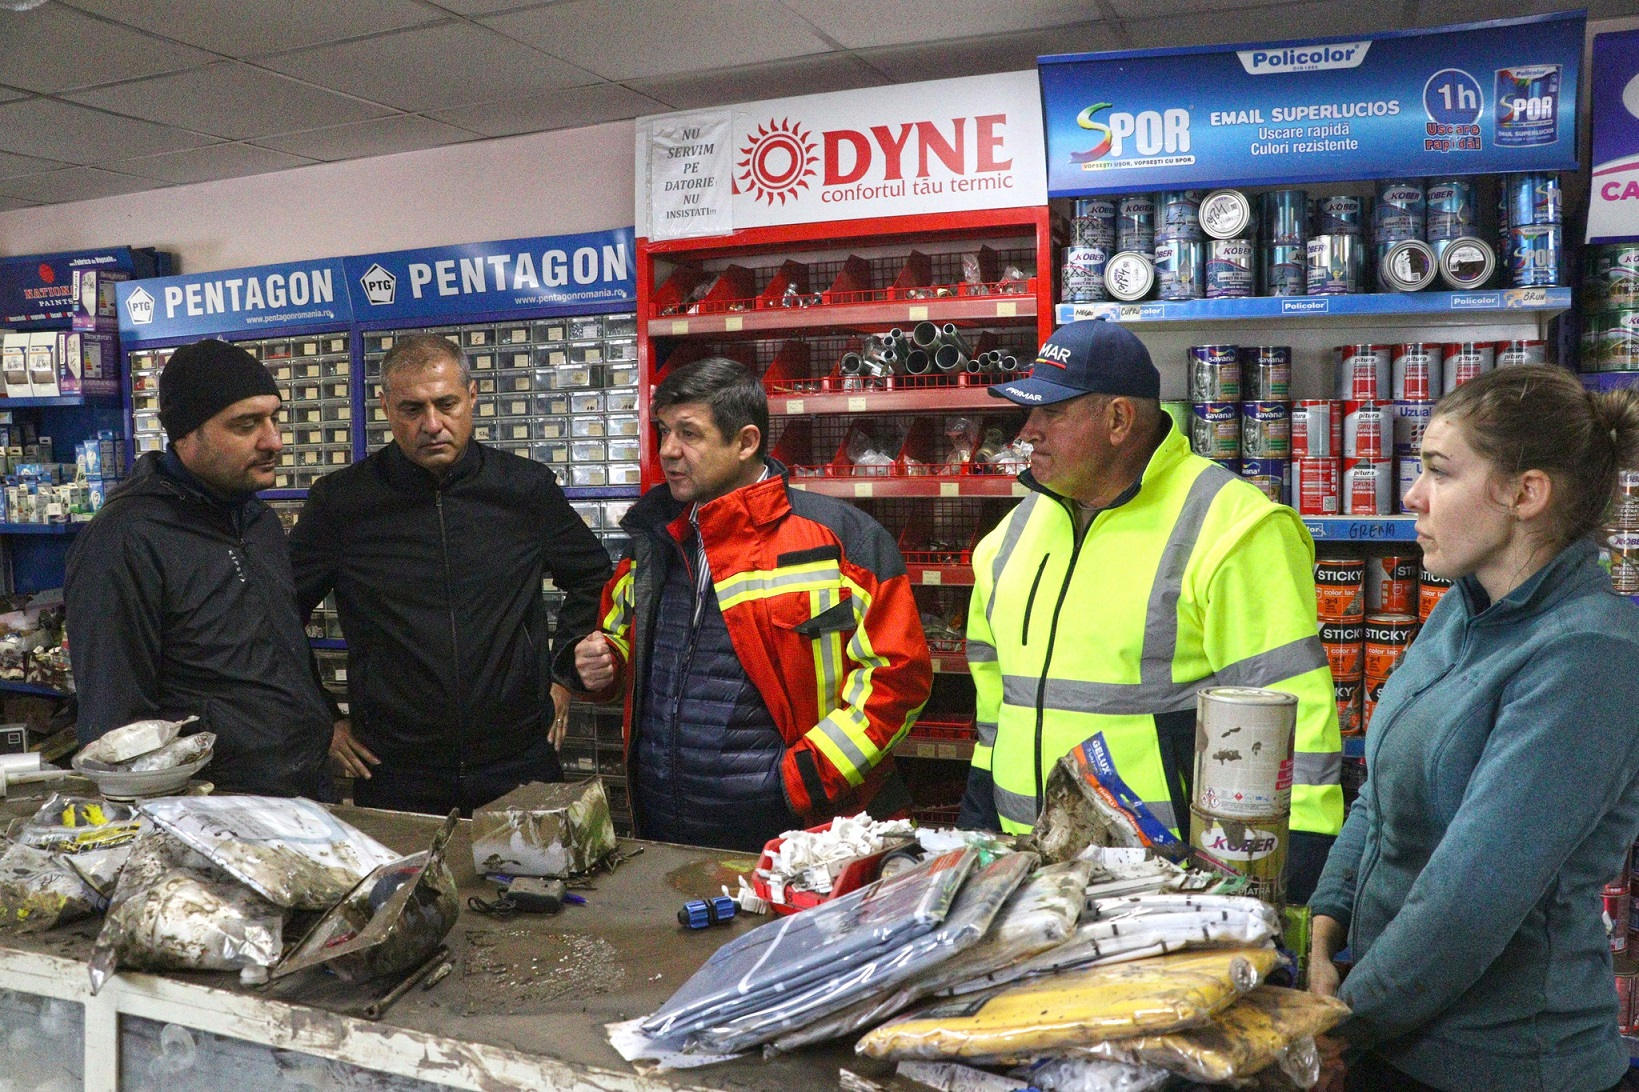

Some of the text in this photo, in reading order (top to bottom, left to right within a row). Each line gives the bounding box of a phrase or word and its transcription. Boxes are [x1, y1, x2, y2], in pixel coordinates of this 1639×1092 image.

[1253, 47, 1355, 68] Policolor
[1210, 100, 1400, 126] EMAIL SUPERLUCIOS
[1499, 93, 1553, 124] SPOR
[681, 128, 700, 141] NU
[1070, 102, 1191, 164] SPOR
[1259, 122, 1350, 140] Uscare rapidă
[1426, 122, 1481, 136] Uscare
[667, 144, 714, 159] SERVIM
[1251, 139, 1358, 155] Culori rezistente
[683, 162, 699, 174] PE
[664, 177, 714, 192] DATORIE
[821, 181, 906, 204] confortul
[950, 174, 1013, 193] termic
[683, 194, 700, 205] NU
[409, 243, 628, 299] PENTAGON
[164, 268, 334, 319] PENTAGON
[369, 280, 392, 292] PTG
[39, 298, 73, 307] PAINTS
[514, 289, 622, 305] www.pentagonromania.ro
[1454, 297, 1496, 305] Policolor
[132, 299, 150, 313] PTG
[1285, 302, 1325, 310] Policolor
[246, 309, 331, 324] www.pentagonromania.ro
[1038, 342, 1071, 364] MAR
[1005, 386, 1042, 402] PRIMAR
[1256, 411, 1284, 419] savana
[1318, 570, 1361, 581] STICKY
[1365, 628, 1407, 640] STICKY
[1092, 739, 1111, 776] GELUX
